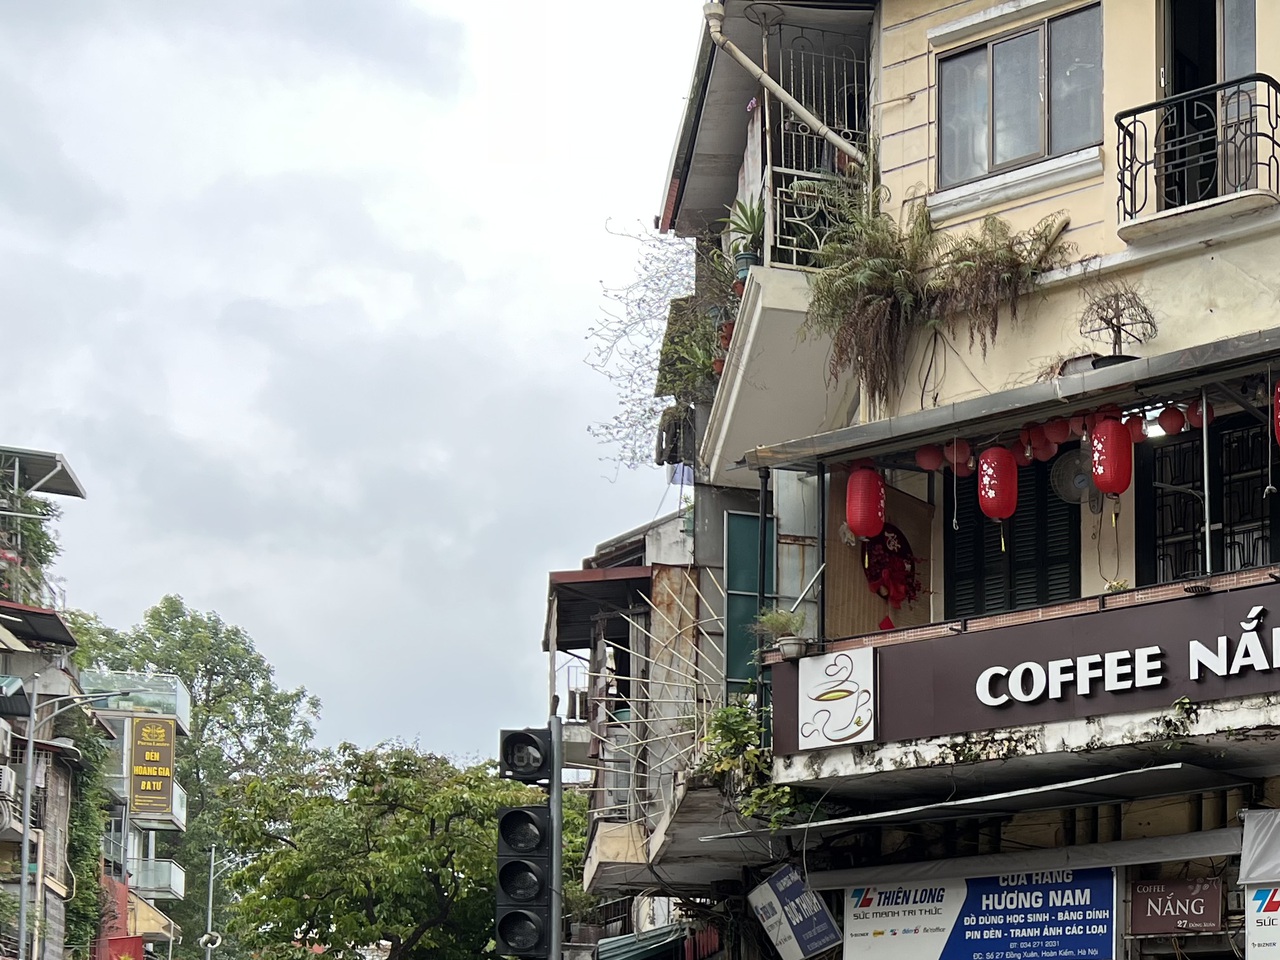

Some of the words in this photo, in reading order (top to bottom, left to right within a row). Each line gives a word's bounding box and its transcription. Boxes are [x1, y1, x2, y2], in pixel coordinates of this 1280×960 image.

[975, 645, 1164, 707] COFFEE
[158, 767, 171, 777] GIA
[141, 781, 152, 791] BA
[1136, 884, 1166, 893] COFFEE
[877, 886, 912, 907] THIÊN
[912, 887, 946, 904] LONG
[981, 889, 1044, 911] HƯƠNG
[1048, 888, 1091, 907] NAM
[1146, 892, 1205, 917] NẮNG
[902, 909, 917, 917] TRI
[963, 913, 977, 926] ĐỒ
[978, 913, 1004, 925] DÙNG
[1006, 914, 1025, 926] HỌC
[1027, 913, 1050, 923] SINH
[1086, 907, 1110, 920] DÍNH
[965, 930, 981, 940] PIN
[983, 927, 1002, 939] ĐÈN
[1009, 927, 1041, 938] TRANH
[1043, 925, 1063, 937] ẢNH
[1065, 923, 1084, 935] CÁC
[1086, 924, 1107, 937] LOẠI
[1177, 920, 1188, 928] 27
[995, 951, 1004, 960] 27
[1005, 950, 1022, 960] Đồng
[1041, 949, 1057, 958] Hoàn
[1077, 948, 1087, 956] Hà
[1087, 947, 1099, 957] Nội
